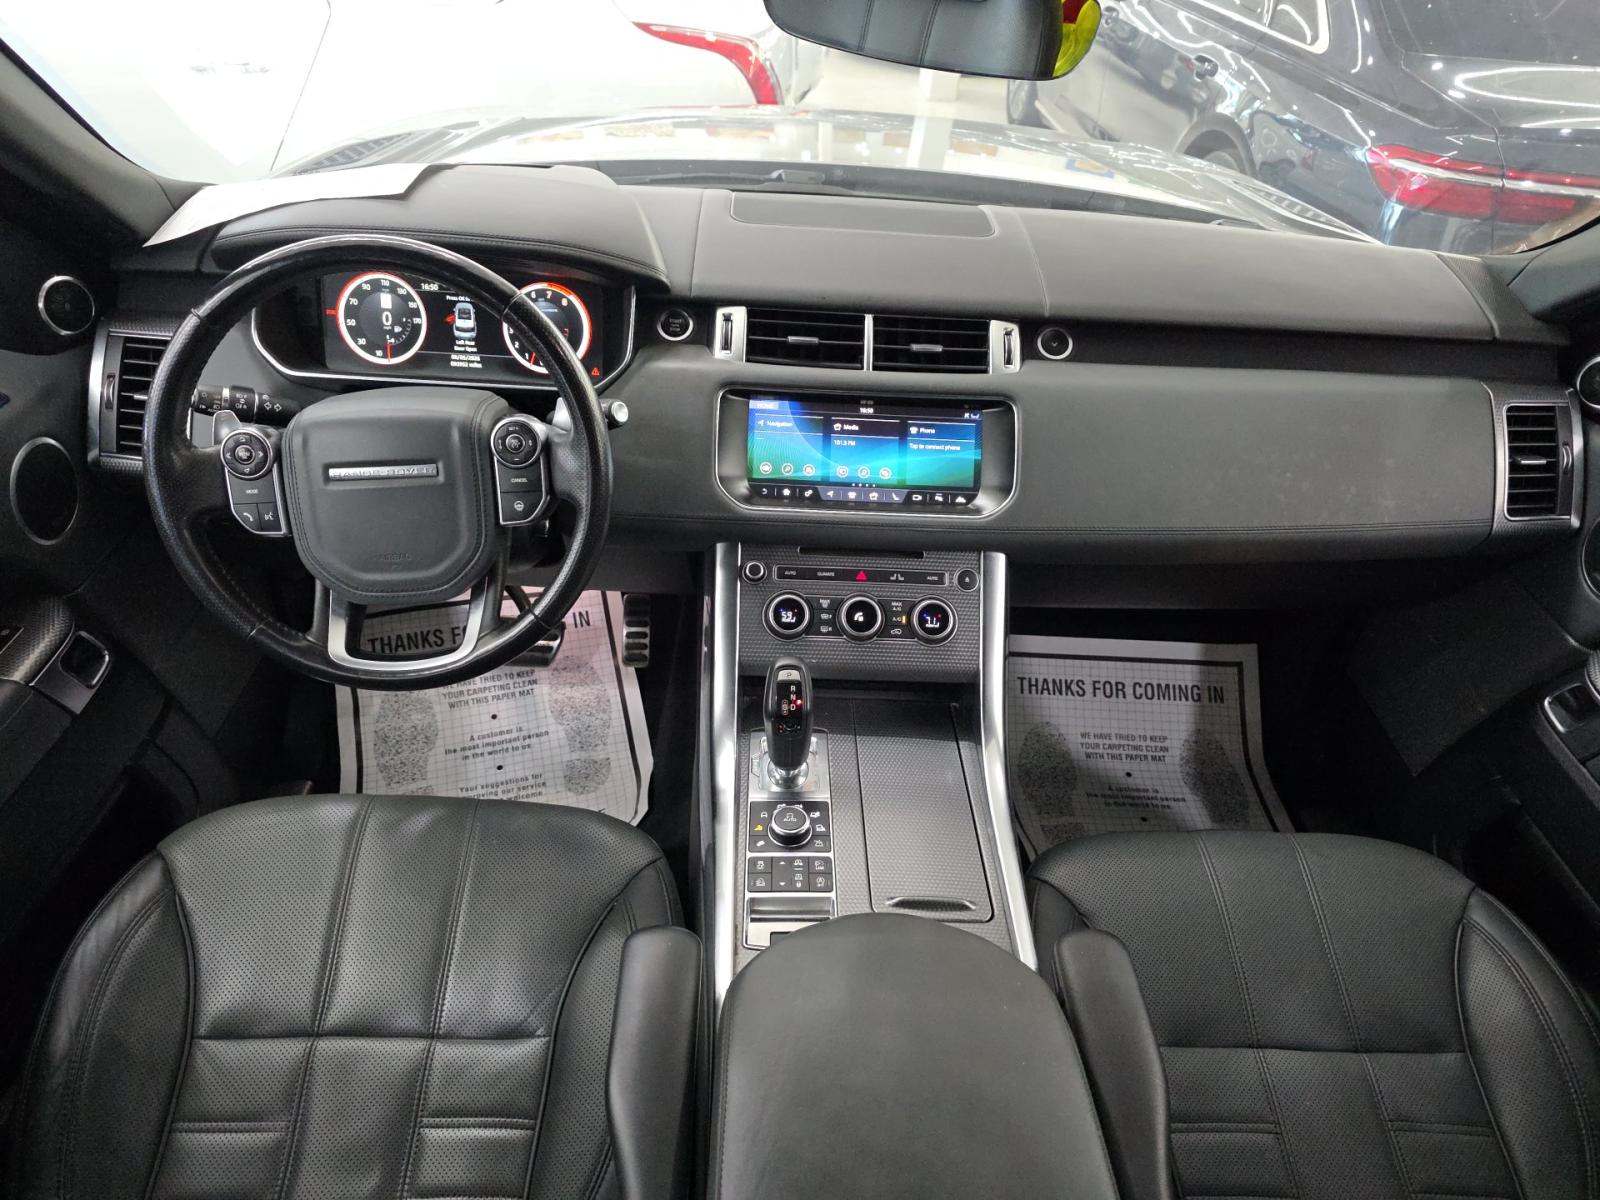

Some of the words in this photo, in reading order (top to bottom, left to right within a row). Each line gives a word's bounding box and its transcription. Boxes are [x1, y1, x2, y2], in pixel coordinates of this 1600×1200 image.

[361, 283, 371, 291] 90
[380, 279, 390, 287] 110
[420, 283, 439, 291] 16:50
[530, 290, 537, 299] 6
[546, 290, 553, 299] 7
[348, 297, 358, 306] 70
[346, 318, 356, 327] 50
[382, 311, 393, 326] 0
[356, 337, 366, 346] 30
[514, 341, 519, 349] 2
[375, 349, 383, 358] 10
[572, 610, 591, 629] IN
[367, 629, 445, 654] THANKS
[504, 672, 514, 680] TO
[516, 669, 536, 678] KEEP
[442, 691, 465, 700] YOUR
[466, 683, 511, 697] CARPETING
[513, 679, 538, 689] CLEAN
[1017, 677, 1086, 697] THANKS
[1092, 681, 1127, 699] FOR
[1132, 682, 1201, 703] COMING
[1207, 686, 1225, 704] IN
[448, 700, 469, 710] WITH
[471, 695, 489, 705] THIS
[491, 692, 517, 703] PAPER
[518, 689, 535, 697] MAT
[477, 729, 513, 740] customer
[1080, 732, 1091, 740] WE
[1093, 733, 1112, 741] HAVE
[1115, 733, 1136, 742] TRIED
[1138, 734, 1148, 743] TO
[1149, 735, 1168, 743] KEEP
[460, 744, 480, 753] most
[482, 737, 521, 749] important
[522, 730, 550, 741] person
[1080, 742, 1100, 750] YOUR
[1102, 743, 1144, 753] CARPETING
[1145, 745, 1169, 753] CLEAN
[1085, 752, 1104, 760] WITH
[1106, 753, 1123, 761] THIS
[1125, 754, 1149, 762] PAPER
[1150, 755, 1166, 763] MAT
[460, 784, 478, 793] Your
[501, 787, 515, 795] our
[517, 781, 546, 792] service
